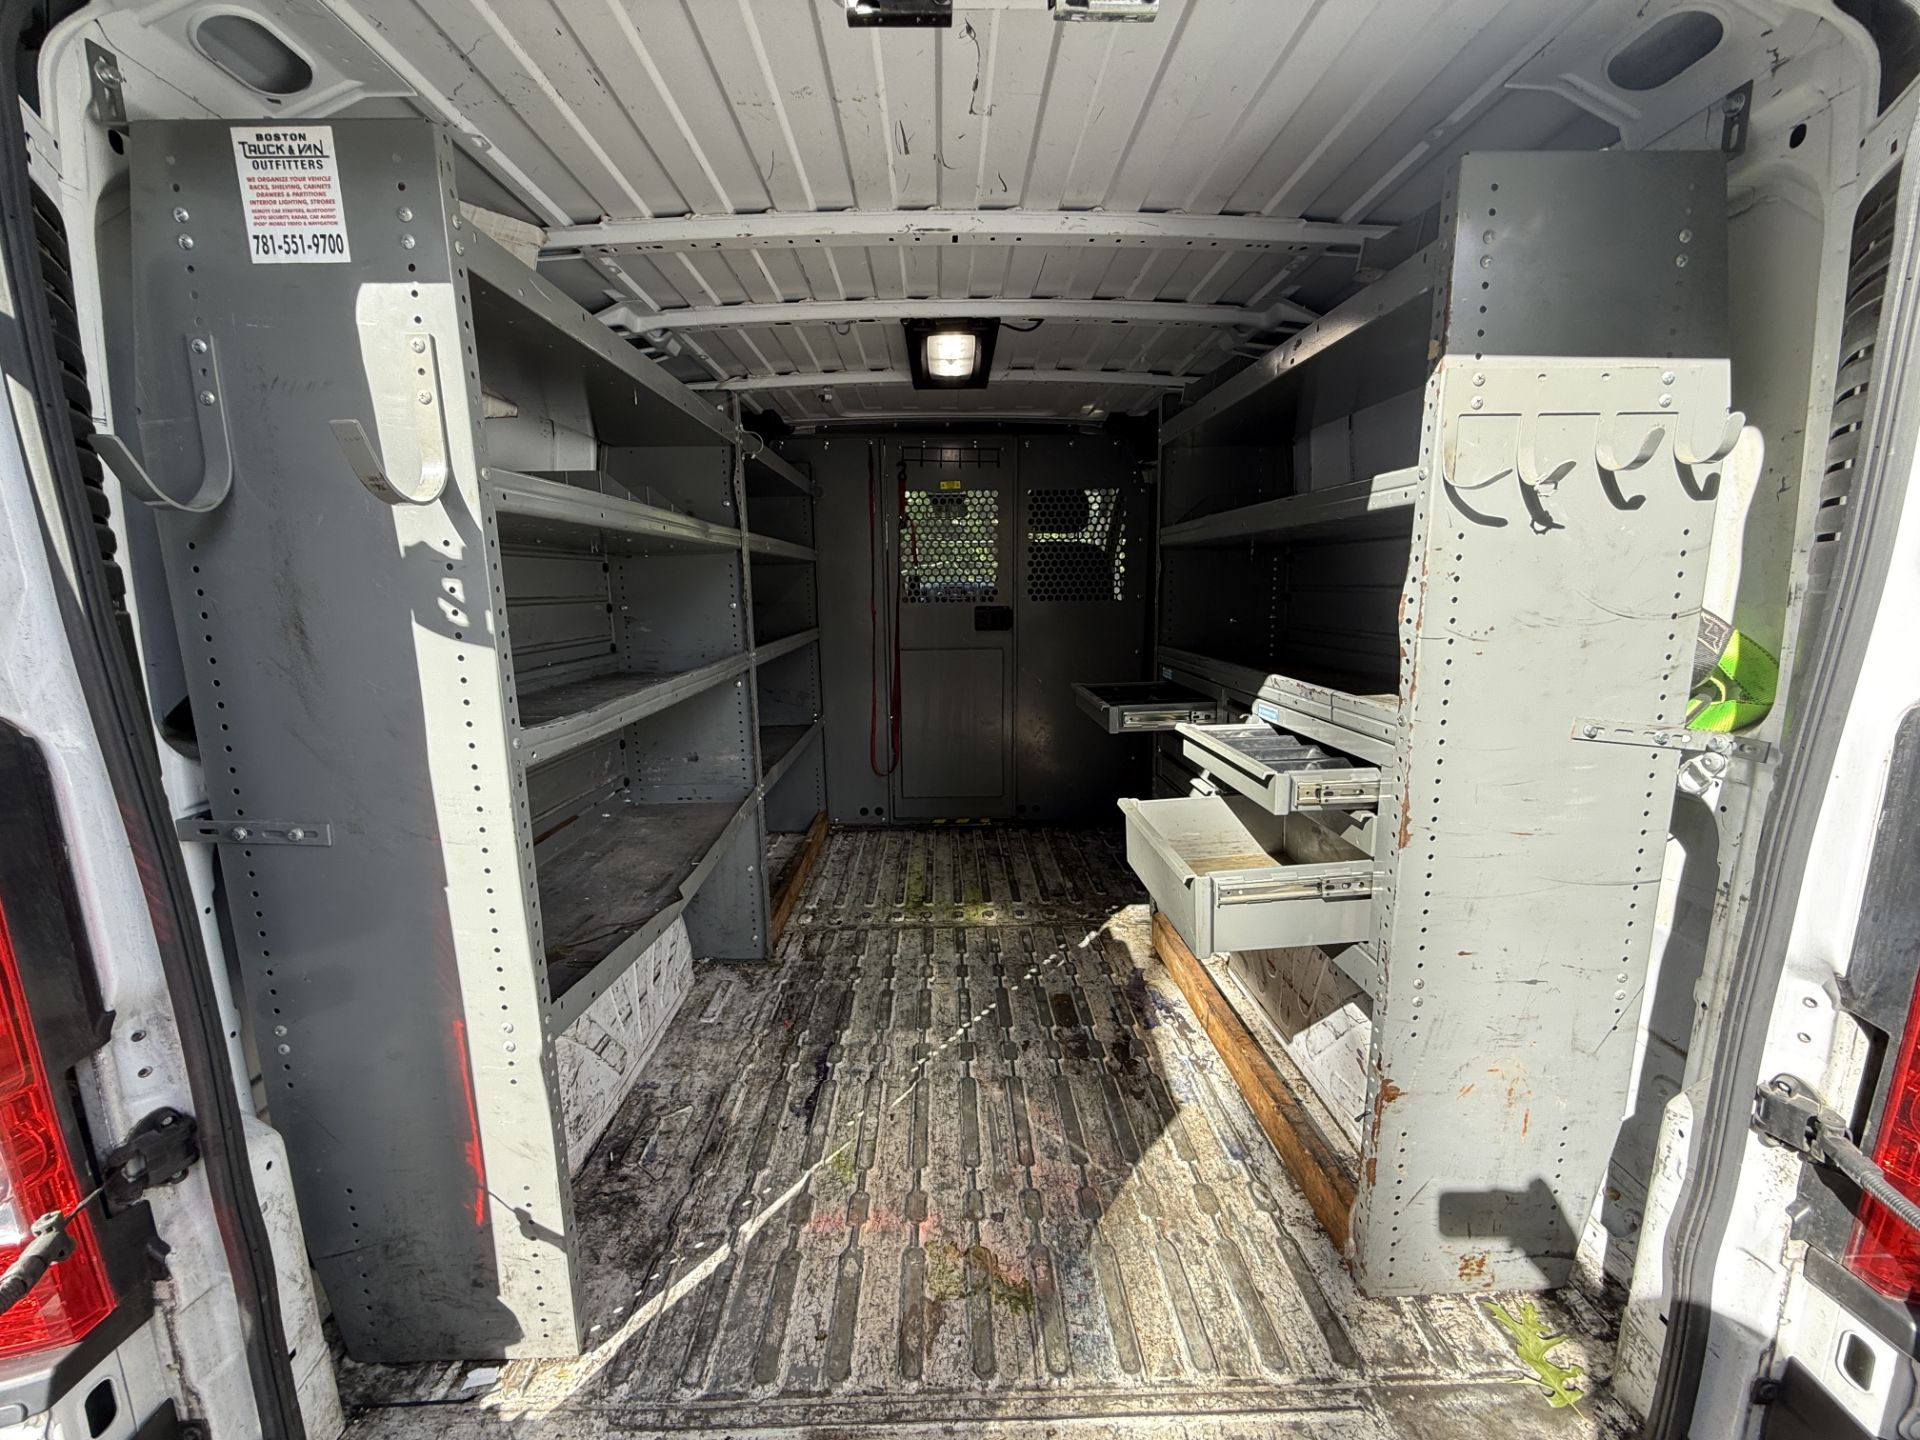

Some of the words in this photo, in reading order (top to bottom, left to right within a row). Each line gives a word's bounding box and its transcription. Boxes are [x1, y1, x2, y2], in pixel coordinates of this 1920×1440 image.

[255, 133, 307, 141] BOSTON
[238, 141, 285, 157] TRUCK
[288, 144, 296, 155] &
[297, 140, 324, 156] VAN
[252, 160, 324, 170] OUTFITTERS
[252, 233, 344, 255] 781-551-9700
